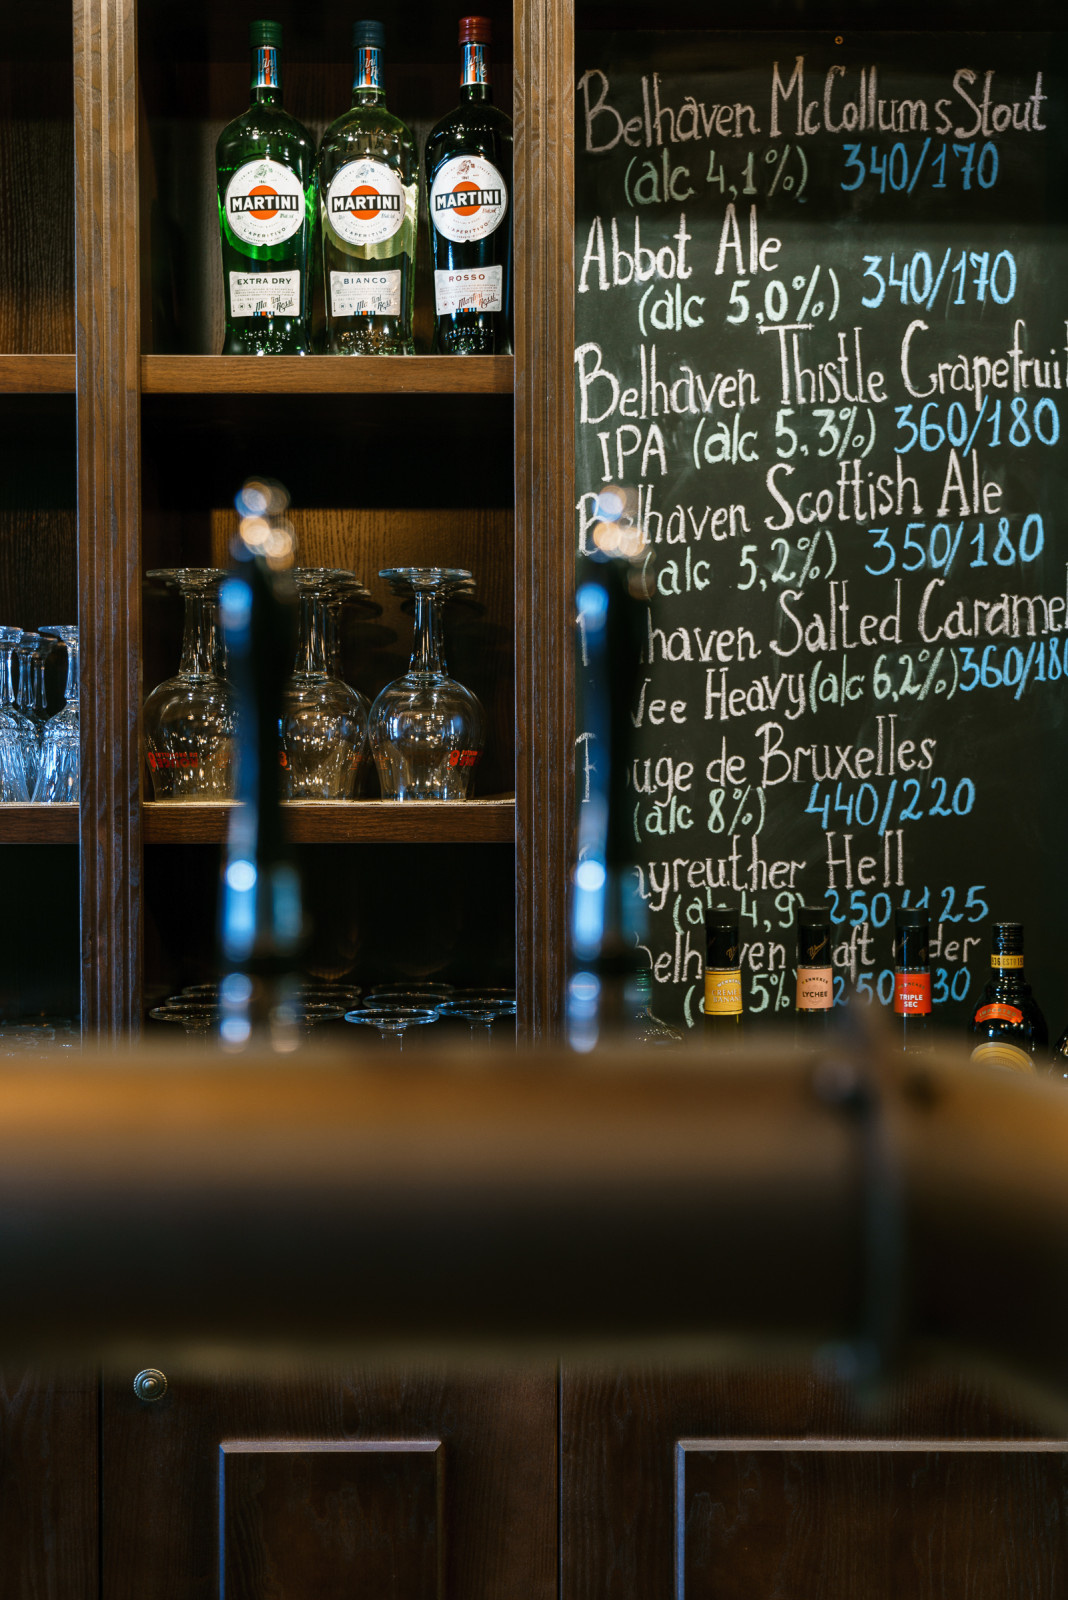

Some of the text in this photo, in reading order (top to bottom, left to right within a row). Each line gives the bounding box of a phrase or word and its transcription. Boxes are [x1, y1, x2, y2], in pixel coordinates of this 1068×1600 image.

[578, 69, 761, 153] Belhaven
[953, 68, 1047, 138] Stout
[232, 196, 296, 211] MARTINI
[334, 196, 398, 211] MARTINI
[436, 191, 499, 209] MARTINI
[624, 147, 696, 207] (alc
[840, 137, 1000, 195] 340/170
[343, 277, 387, 285] BIANCO
[448, 274, 486, 282] ROSSO
[578, 203, 782, 293] Abbot Ale
[638, 248, 1017, 336] (alc 5,0%) 340/170
[574, 342, 760, 425] Belhaven
[757, 323, 886, 406] Thistle
[599, 425, 668, 482] IPA
[693, 413, 760, 469] (alc
[894, 395, 1060, 457] 360/180
[764, 455, 924, 532] Scottish
[937, 448, 1003, 517] Ale
[737, 530, 838, 591] 5,2%)
[864, 513, 1045, 577] 350/180
[769, 579, 902, 657] Salted
[704, 667, 806, 723] Heavy
[873, 647, 960, 702] 6,2%)
[706, 736, 747, 788] de
[755, 714, 938, 789] Bruxelles
[633, 777, 977, 843] (alc 8%) 440/220
[634, 829, 905, 912] ayreuther Hell
[899, 993, 924, 1001] TRIPLE
